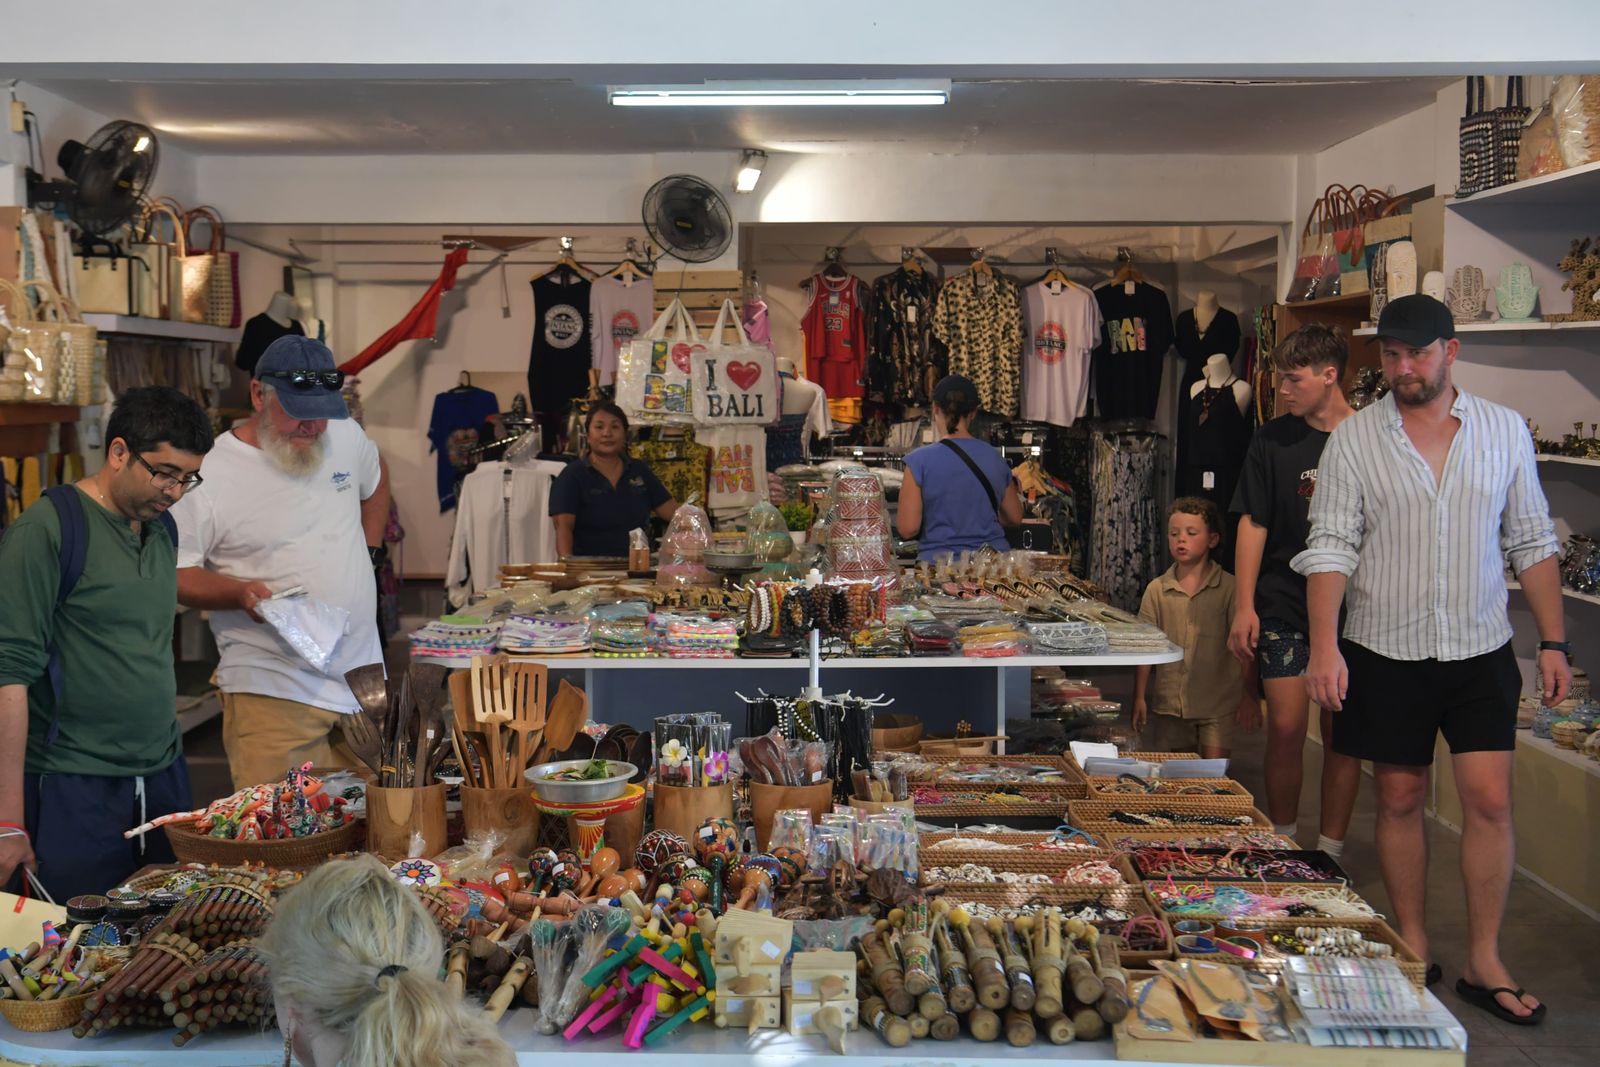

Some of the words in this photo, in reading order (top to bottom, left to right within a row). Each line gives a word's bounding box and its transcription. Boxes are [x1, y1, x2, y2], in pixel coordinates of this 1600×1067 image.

[825, 317, 843, 331] 23
[705, 359, 717, 391] I
[707, 393, 764, 417] BALI
